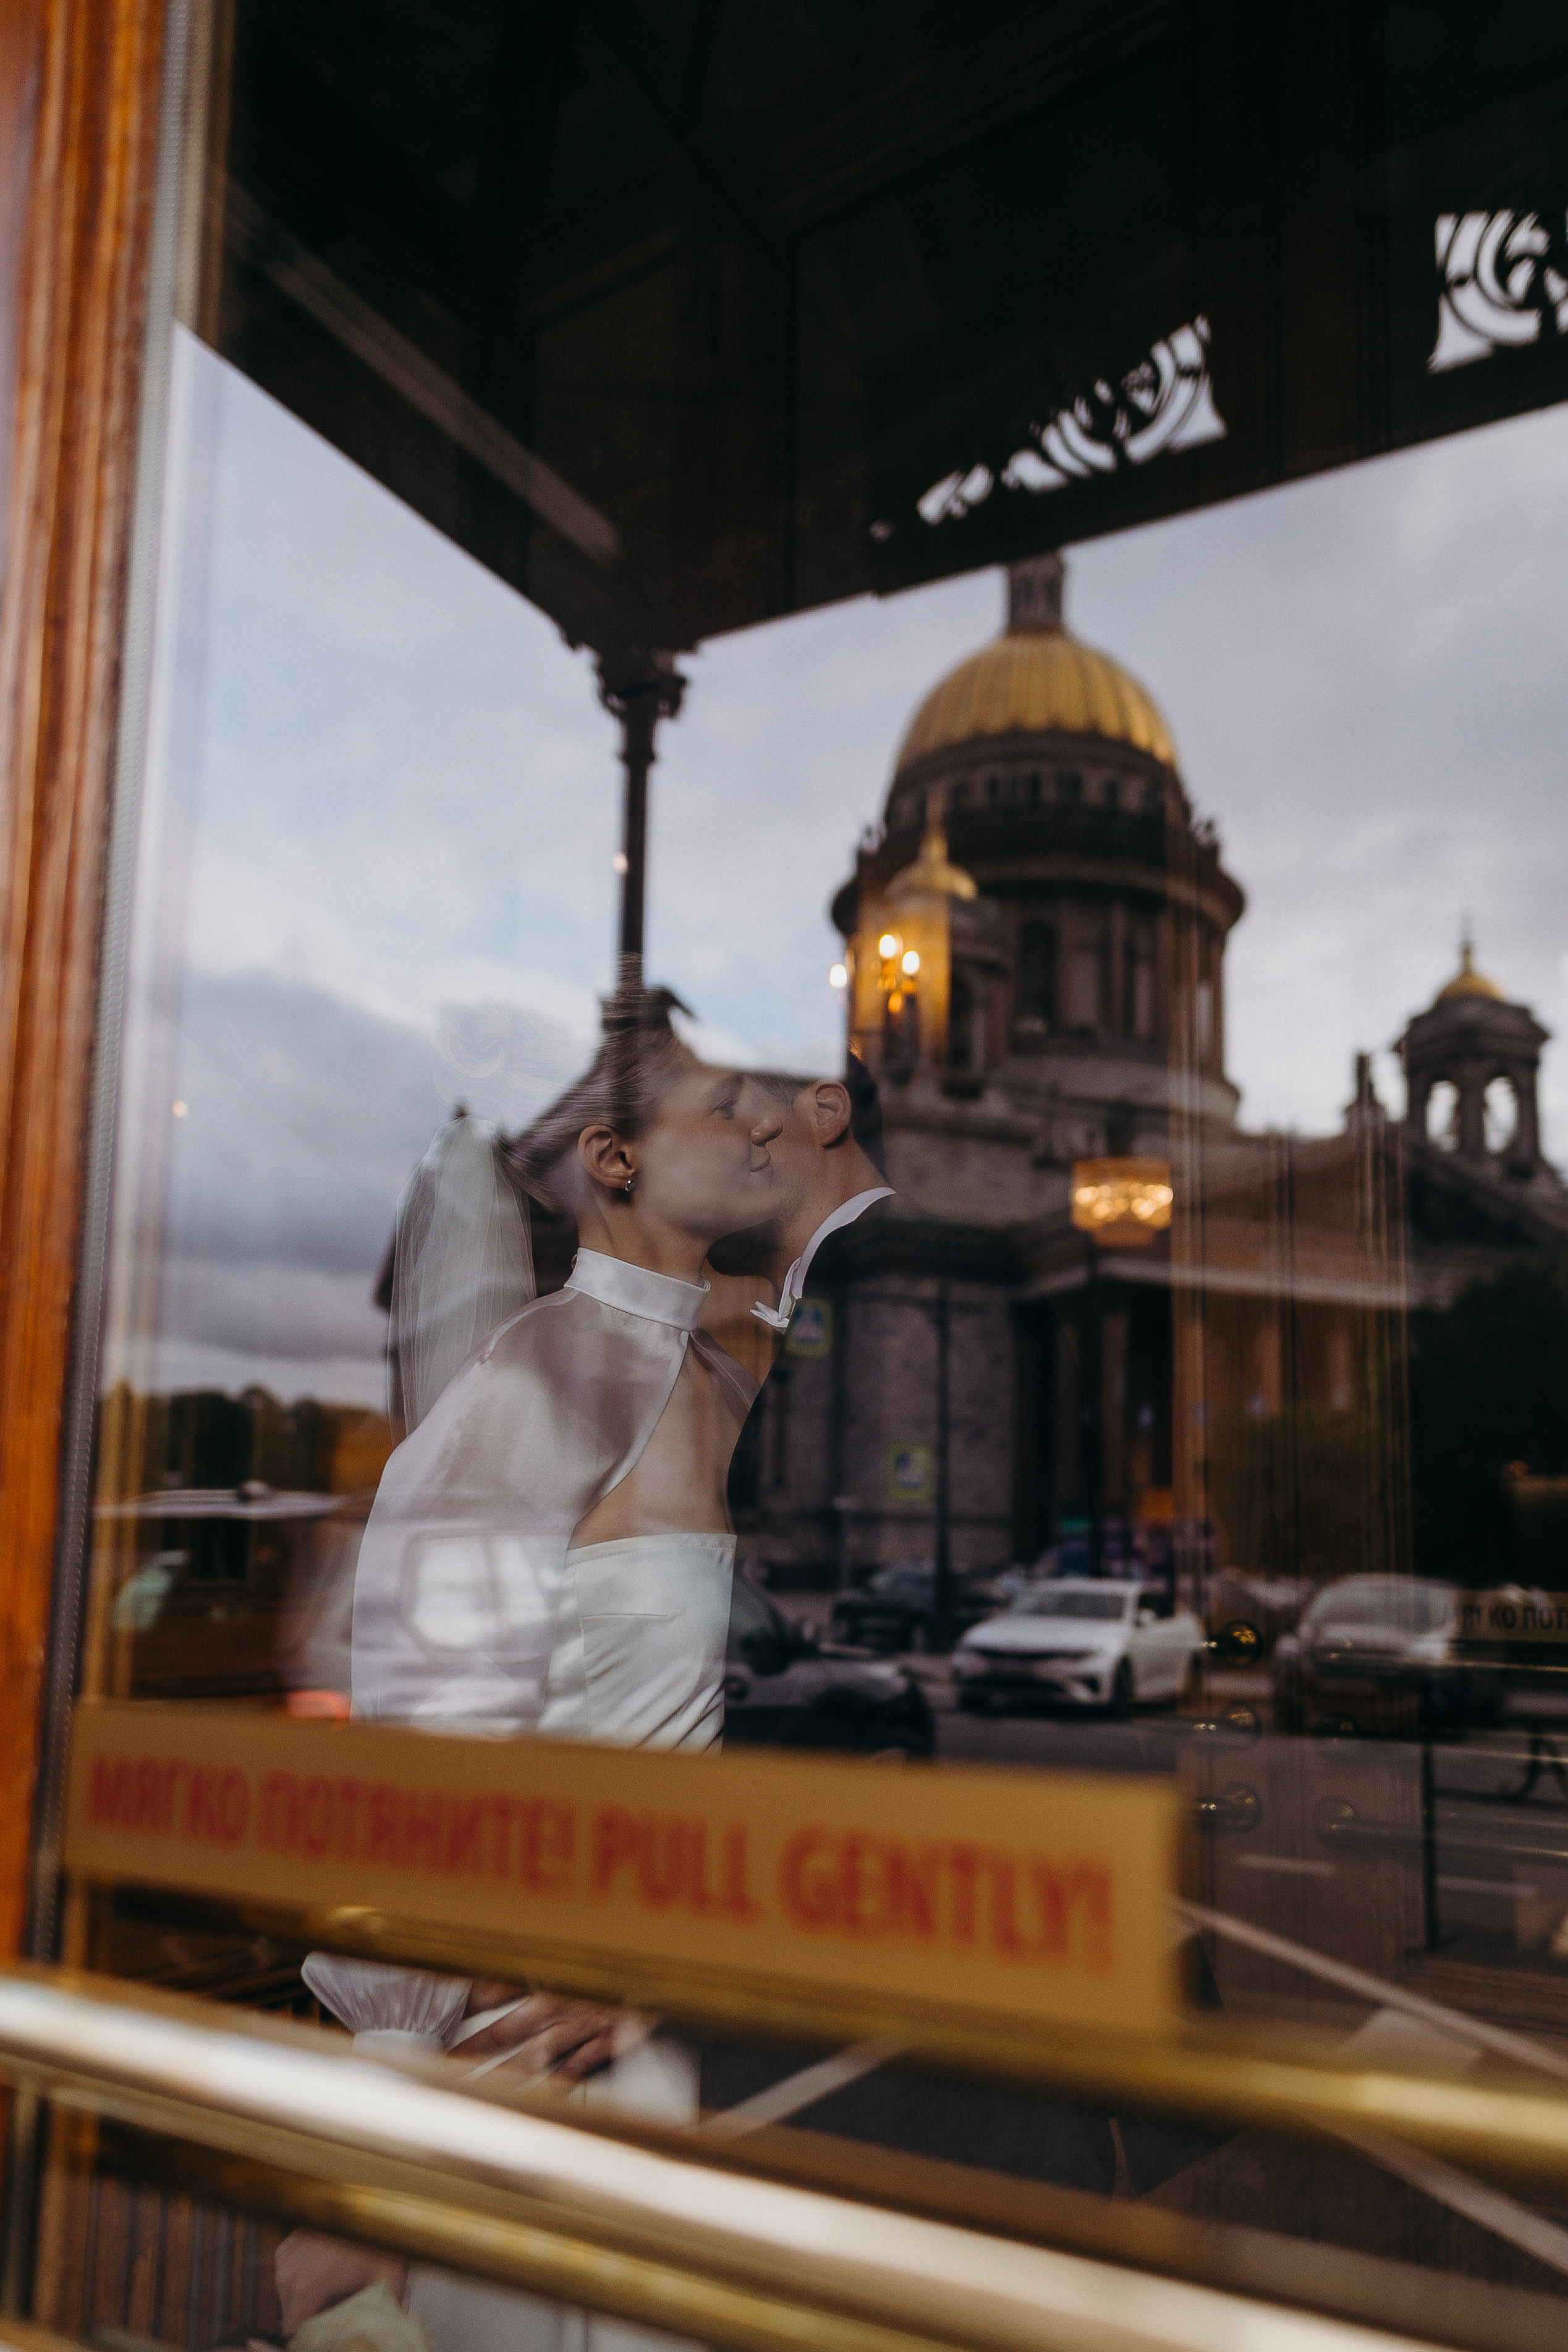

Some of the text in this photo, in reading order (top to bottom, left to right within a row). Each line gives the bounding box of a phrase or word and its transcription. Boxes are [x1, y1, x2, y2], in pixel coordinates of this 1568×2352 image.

[90, 1754, 245, 1848] МЯГКО
[591, 1803, 764, 1929] PULL
[778, 1825, 1116, 1975] GENTLY!
